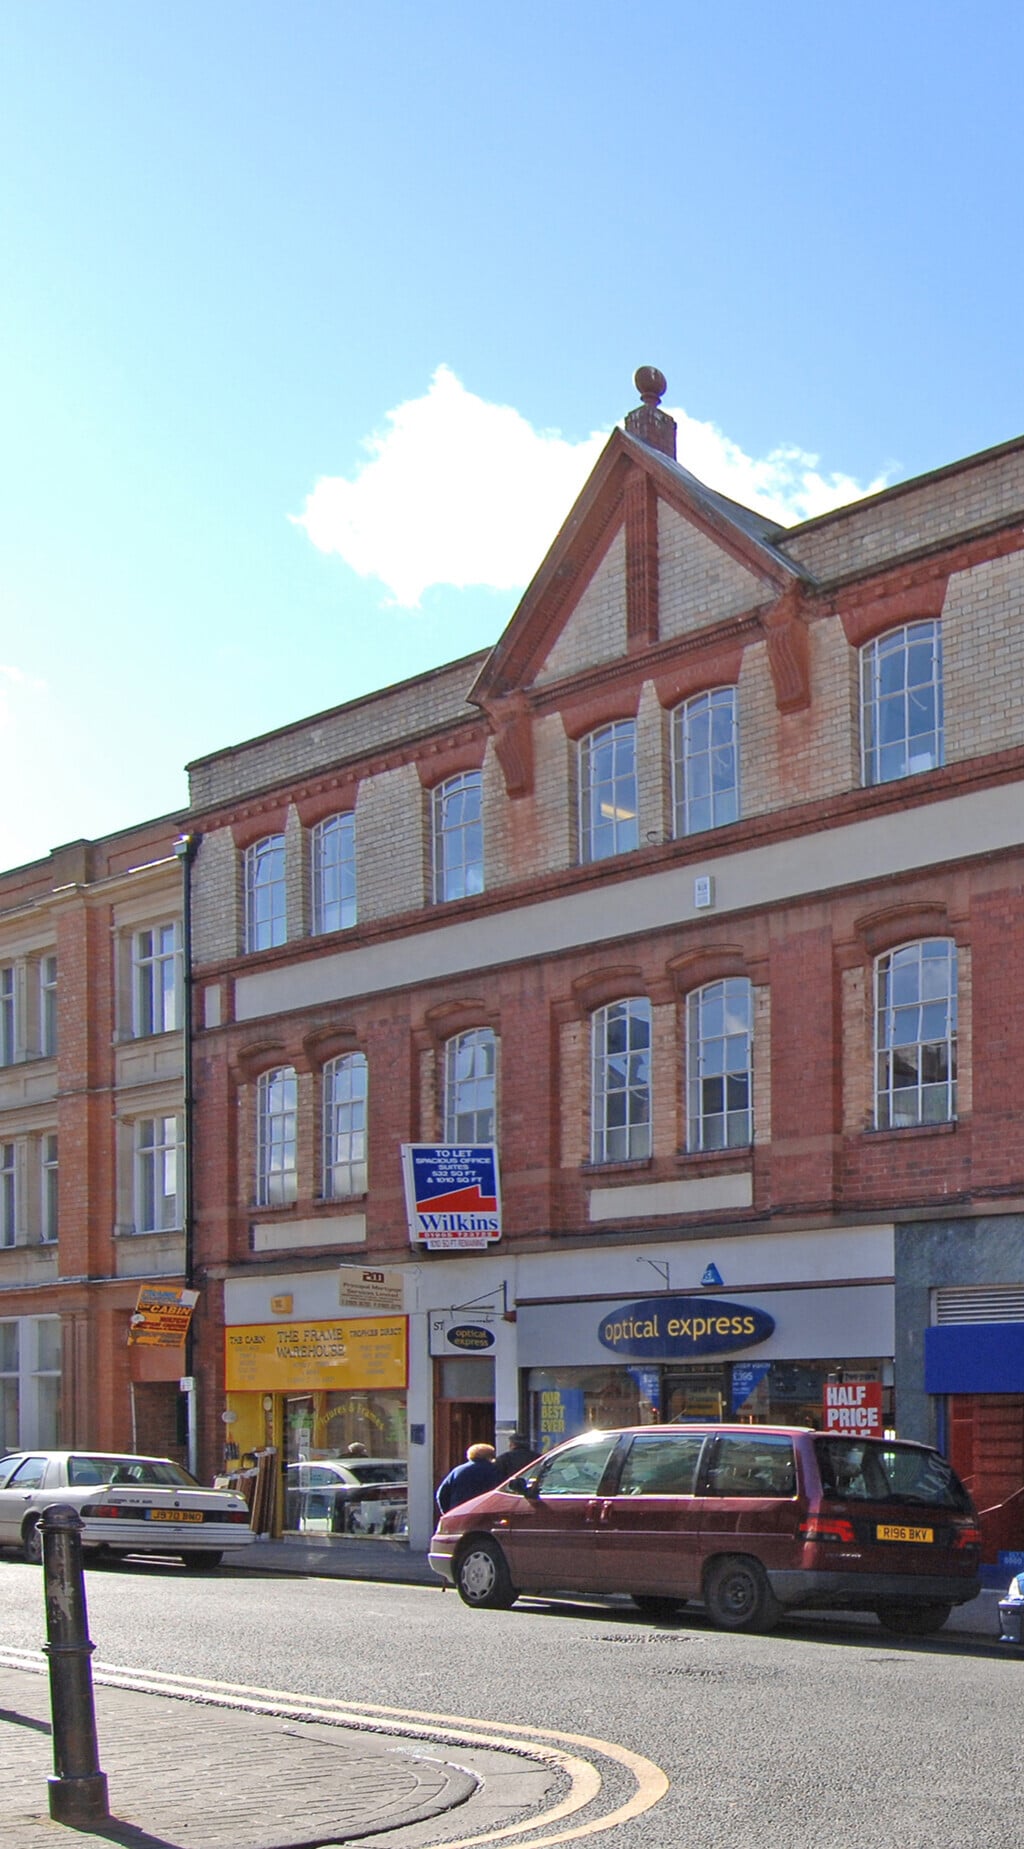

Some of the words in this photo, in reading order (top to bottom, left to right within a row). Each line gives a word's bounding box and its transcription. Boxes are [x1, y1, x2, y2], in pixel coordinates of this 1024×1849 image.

[419, 1214, 498, 1231] Wilkins
[150, 1304, 192, 1315] CABIN
[277, 1330, 299, 1343] THE
[304, 1328, 343, 1343] FRAME
[455, 1329, 487, 1338] optical
[605, 1314, 659, 1345] optical
[667, 1316, 755, 1341] express
[454, 1338, 488, 1346] express
[276, 1344, 345, 1358] WAREHOUSE
[542, 1391, 560, 1405] OUR
[827, 1386, 866, 1406] HALF
[541, 1405, 565, 1419] BEST
[827, 1407, 879, 1428] PRICE
[541, 1419, 565, 1432] EVER
[883, 1527, 906, 1539] R196
[909, 1529, 928, 1540] BKV
